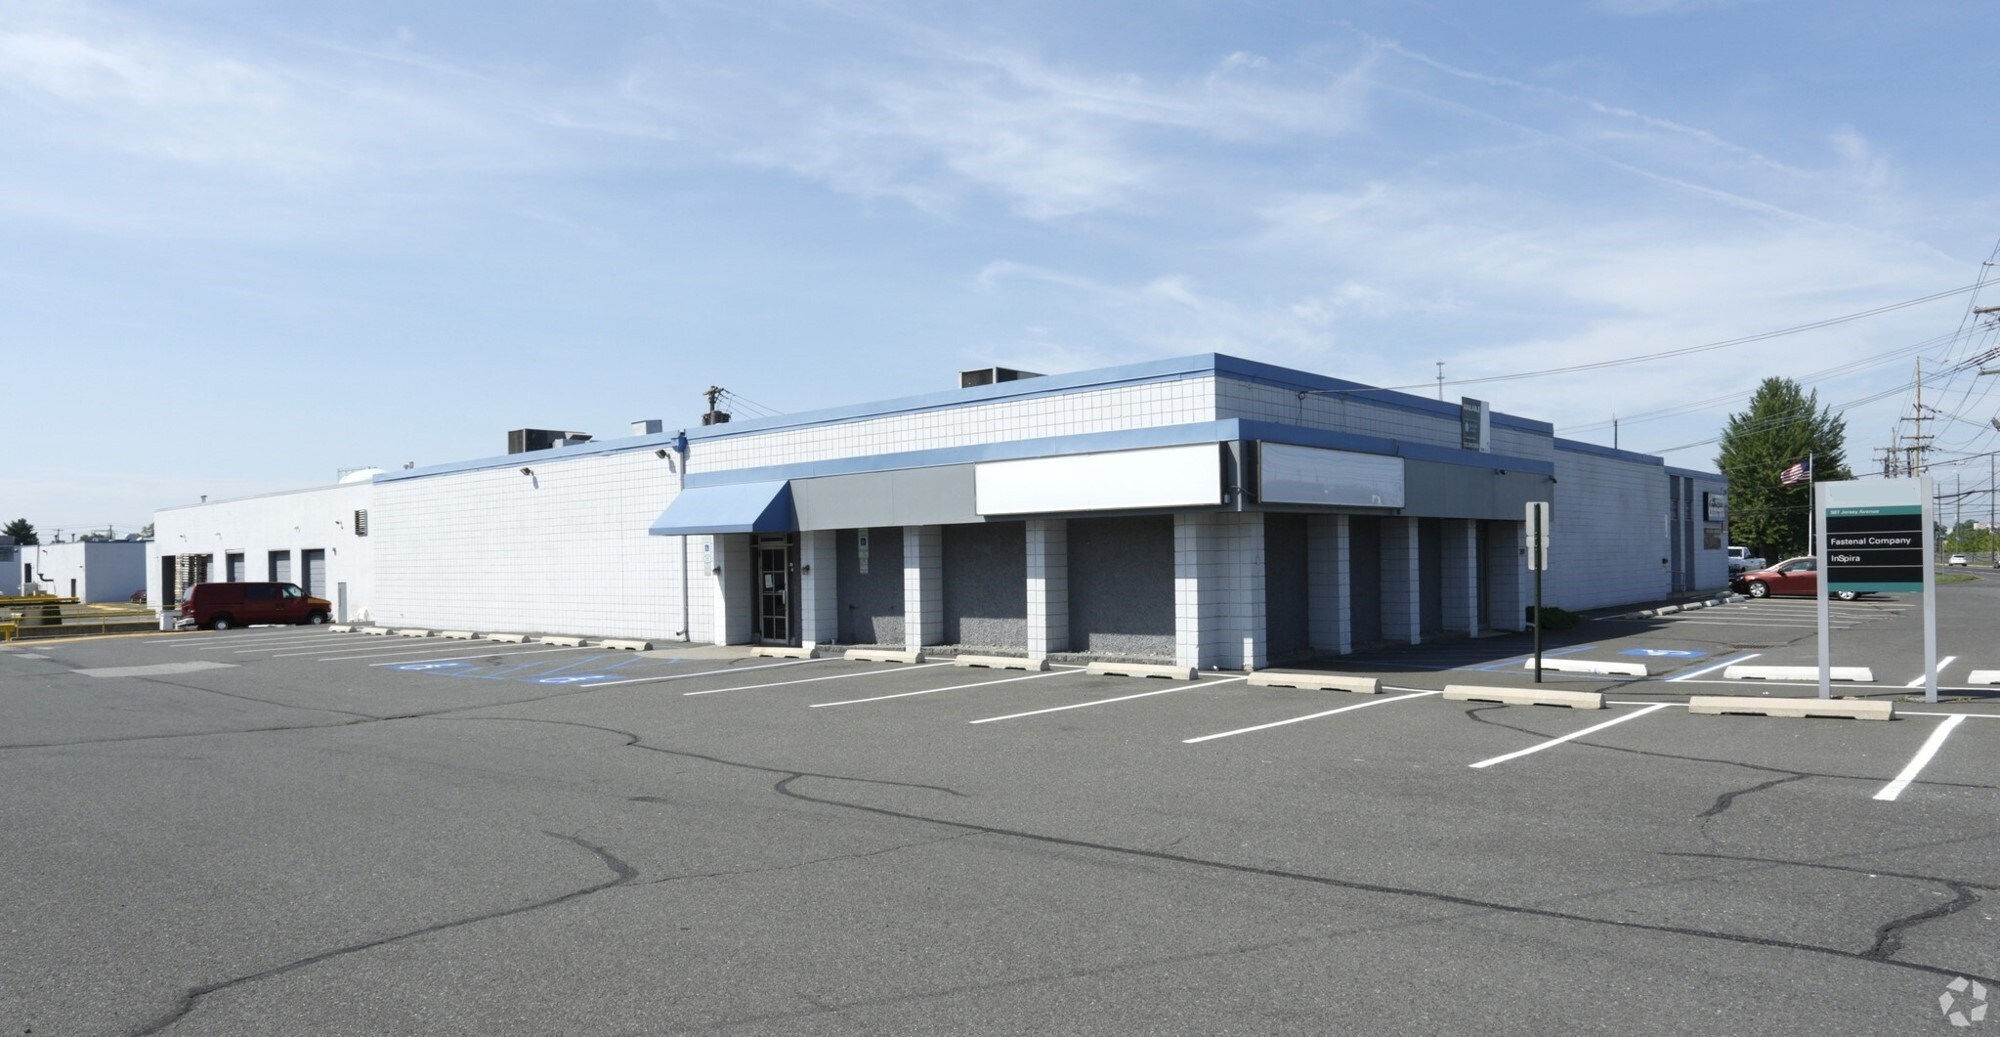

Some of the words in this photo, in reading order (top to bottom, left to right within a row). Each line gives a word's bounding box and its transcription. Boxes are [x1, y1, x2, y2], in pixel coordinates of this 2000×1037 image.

[1831, 537, 1866, 545] Fastenal
[1868, 537, 1911, 545] Company
[1831, 554, 1861, 563] InSpira
